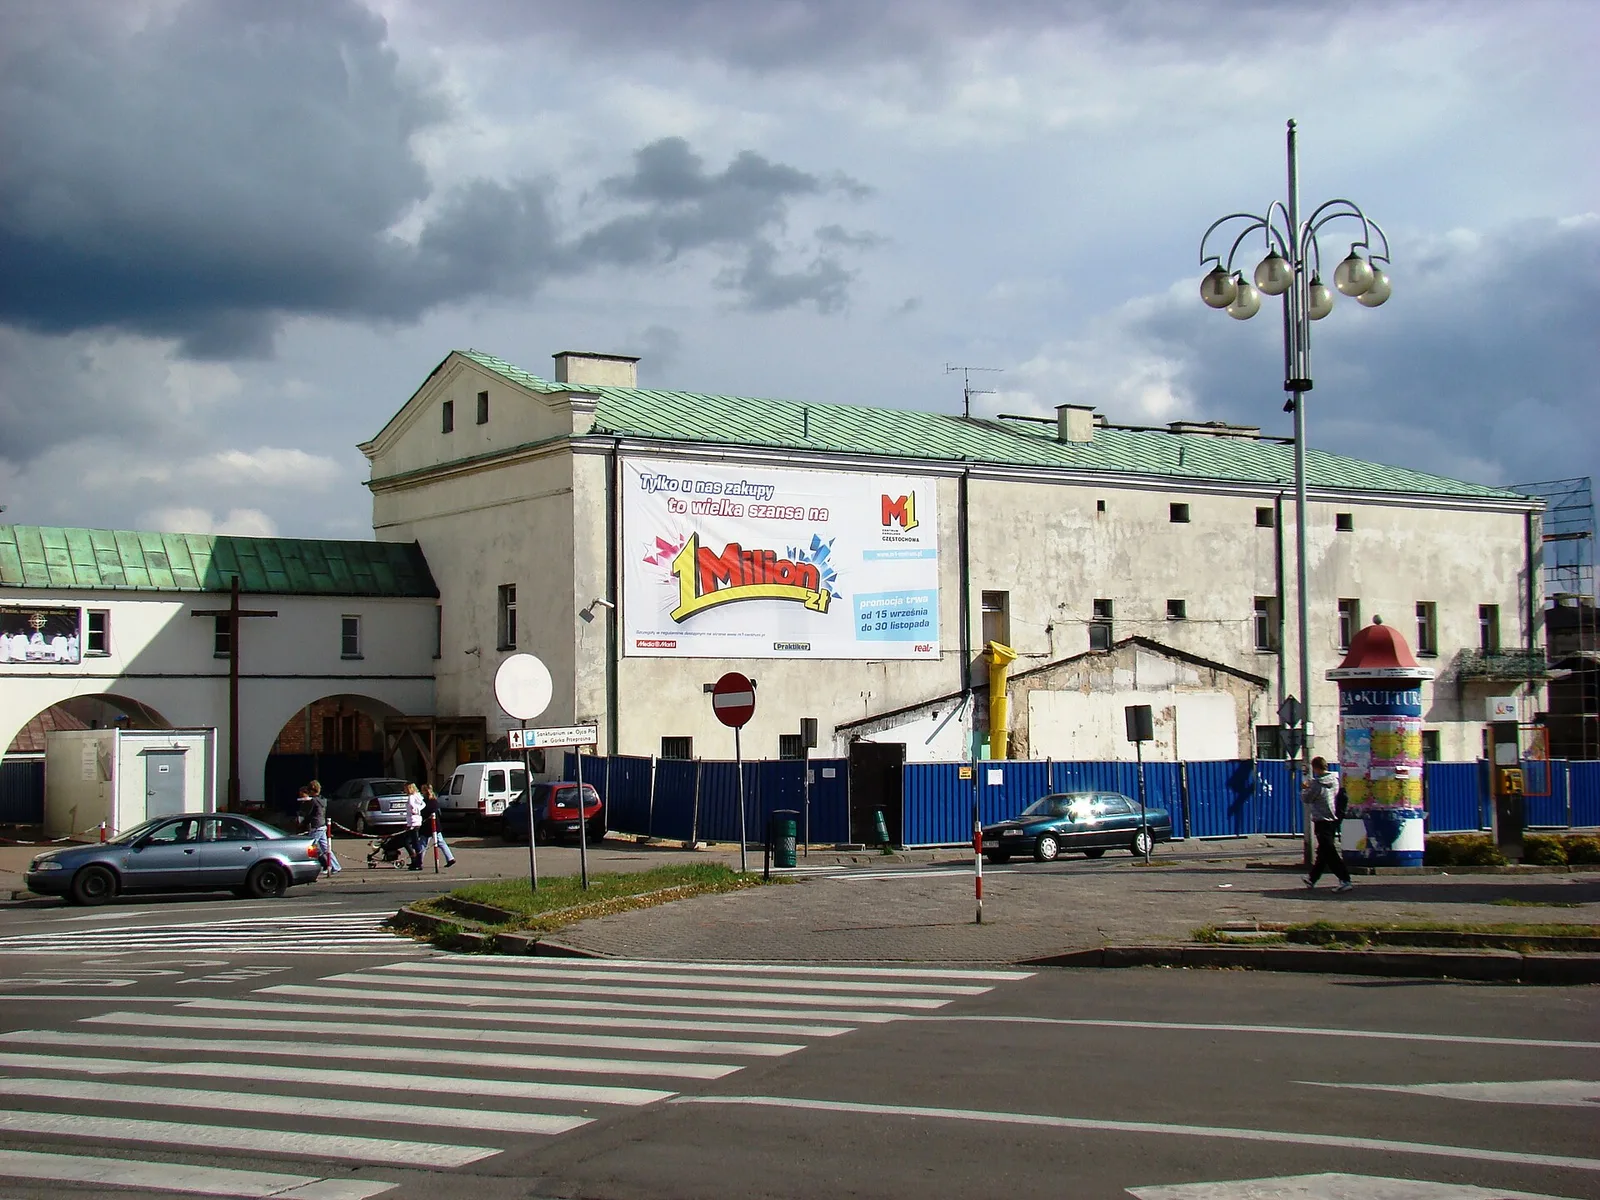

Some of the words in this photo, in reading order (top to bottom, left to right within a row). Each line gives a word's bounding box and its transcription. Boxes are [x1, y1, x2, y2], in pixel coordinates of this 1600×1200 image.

[640, 473, 679, 493] Tylko
[681, 480, 693, 492] u
[695, 481, 722, 495] nas
[724, 480, 775, 501] zakupy
[667, 497, 687, 514] to
[691, 498, 744, 517] wielka
[748, 504, 804, 520] szansa
[808, 507, 829, 522] na
[881, 490, 919, 532] M1
[698, 542, 821, 594] Milion
[804, 588, 831, 614] zł
[859, 596, 904, 610] promocja
[906, 595, 928, 605] trwa
[861, 611, 872, 620] od
[875, 609, 887, 619] 15
[890, 608, 928, 618] września
[861, 623, 872, 632] do
[875, 622, 888, 631] 30
[890, 619, 930, 631] listopada
[176, 966, 294, 984] TAXI
